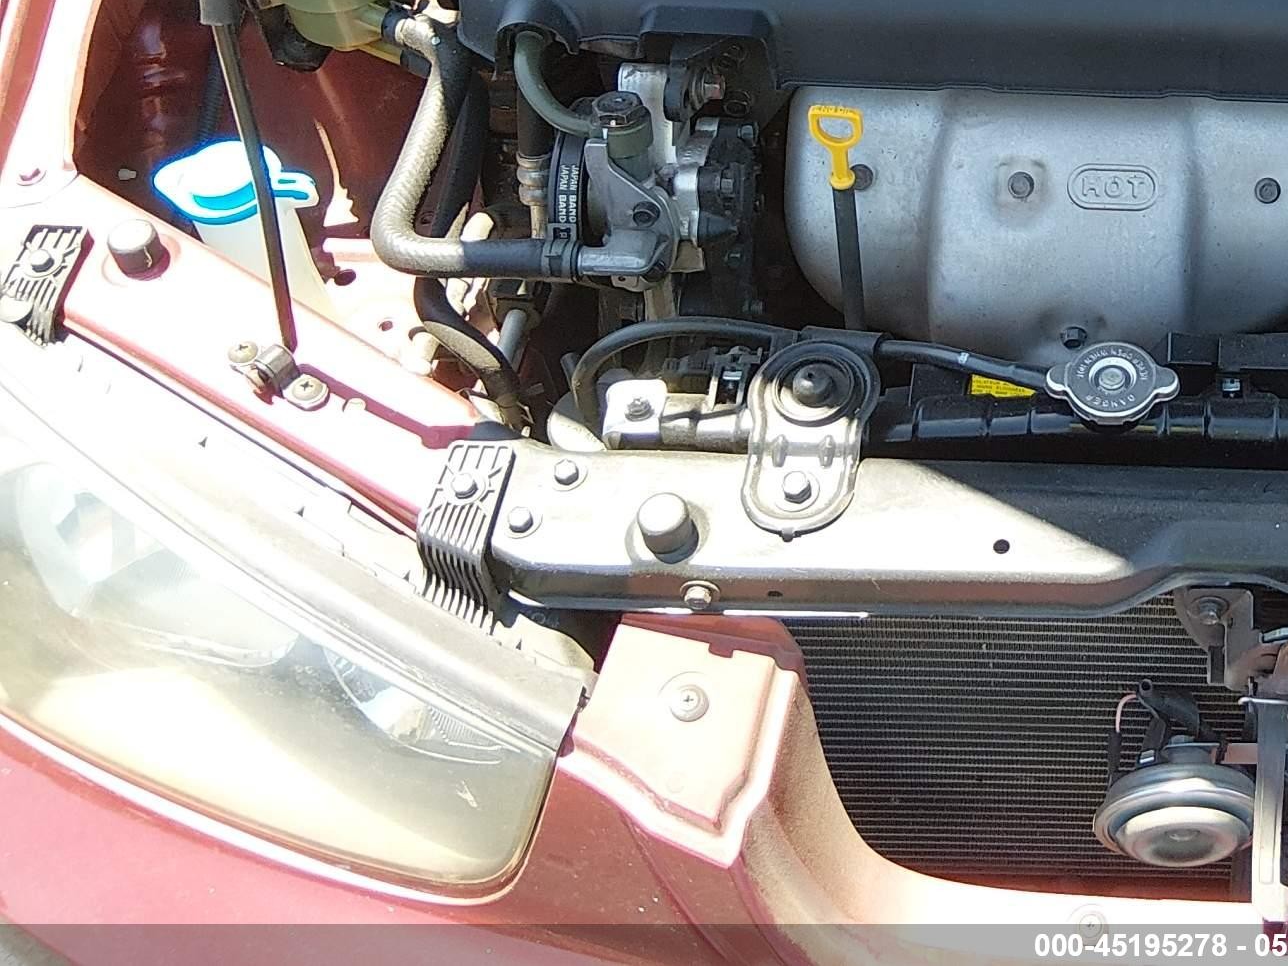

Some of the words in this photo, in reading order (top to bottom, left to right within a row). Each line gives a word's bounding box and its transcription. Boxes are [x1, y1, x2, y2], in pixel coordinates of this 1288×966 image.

[559, 165, 569, 191] JAPAN
[570, 165, 579, 191] JAPAN
[1081, 175, 1146, 199] HOT
[558, 195, 567, 223] BAND
[568, 195, 577, 223] BAND
[1086, 394, 1136, 408] DANGER
